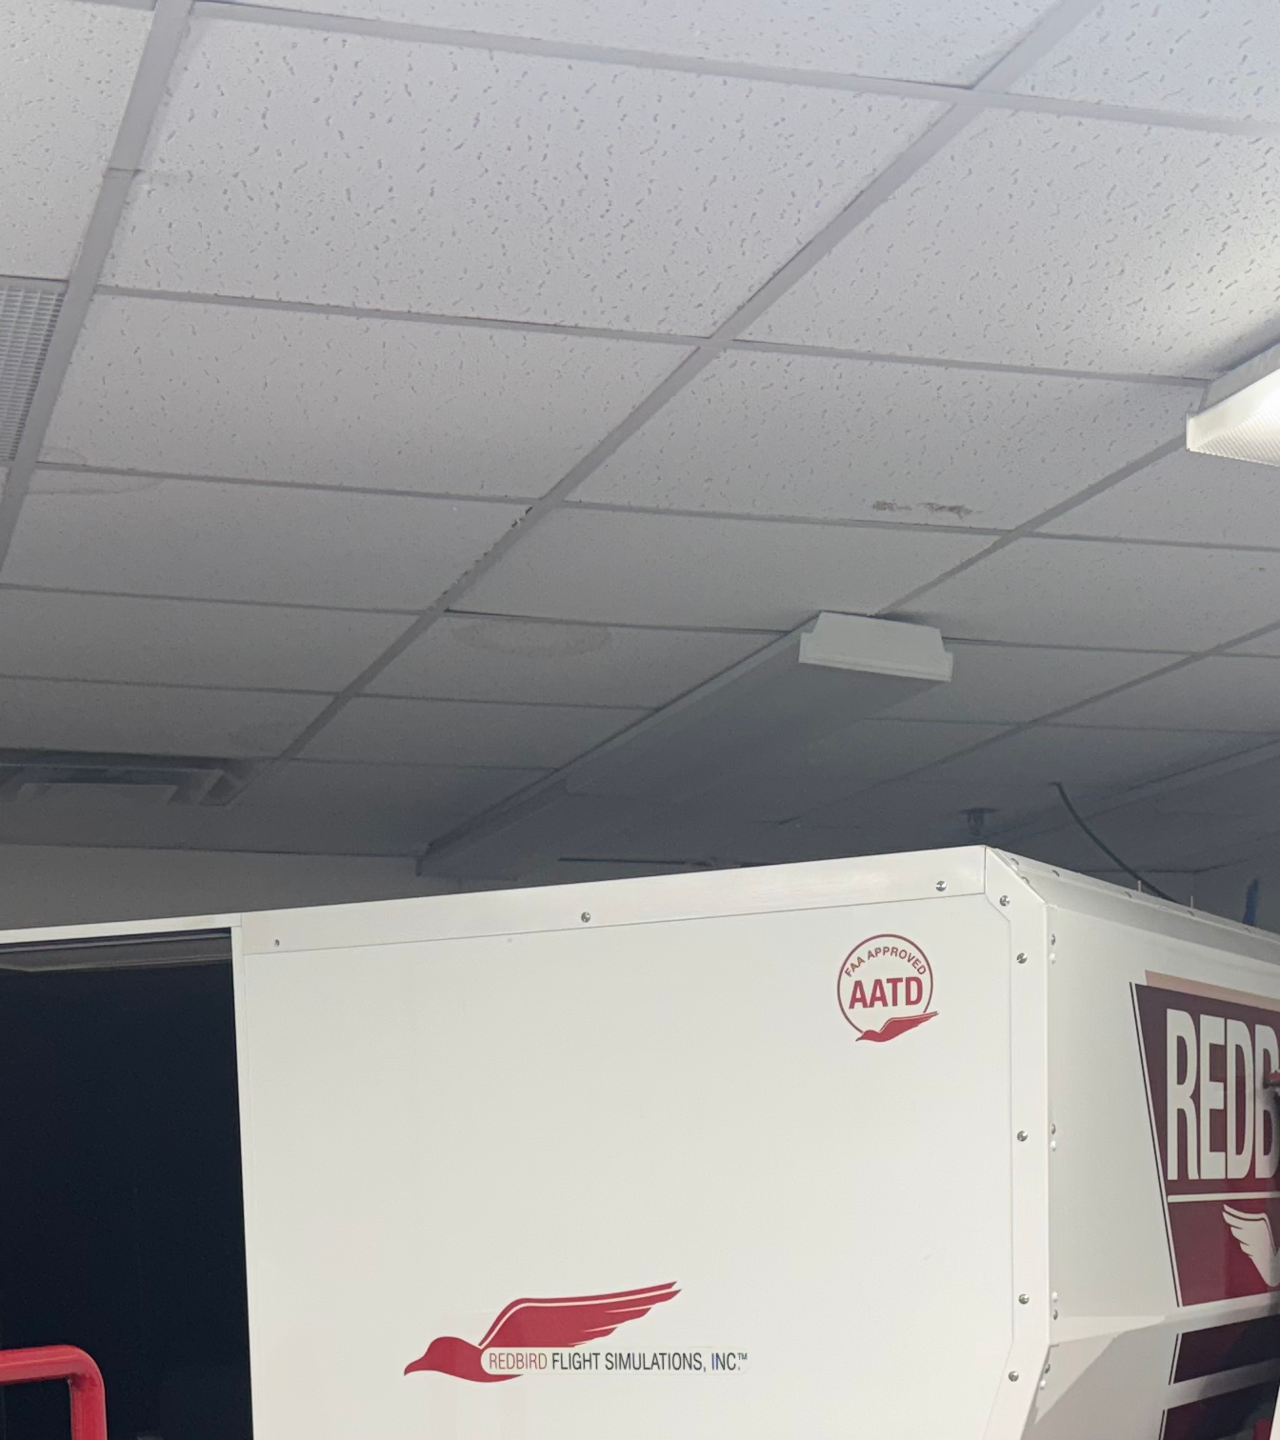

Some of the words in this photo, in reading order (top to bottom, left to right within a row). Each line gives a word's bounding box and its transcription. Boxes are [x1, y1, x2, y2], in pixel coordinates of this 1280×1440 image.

[844, 956, 866, 978] FAA
[867, 946, 926, 976] APPROVED
[848, 976, 923, 1009] AATD
[489, 1352, 548, 1370] REDBIRD
[552, 1352, 601, 1370] FLIGHT
[605, 1352, 706, 1373] SIMULATIONS,
